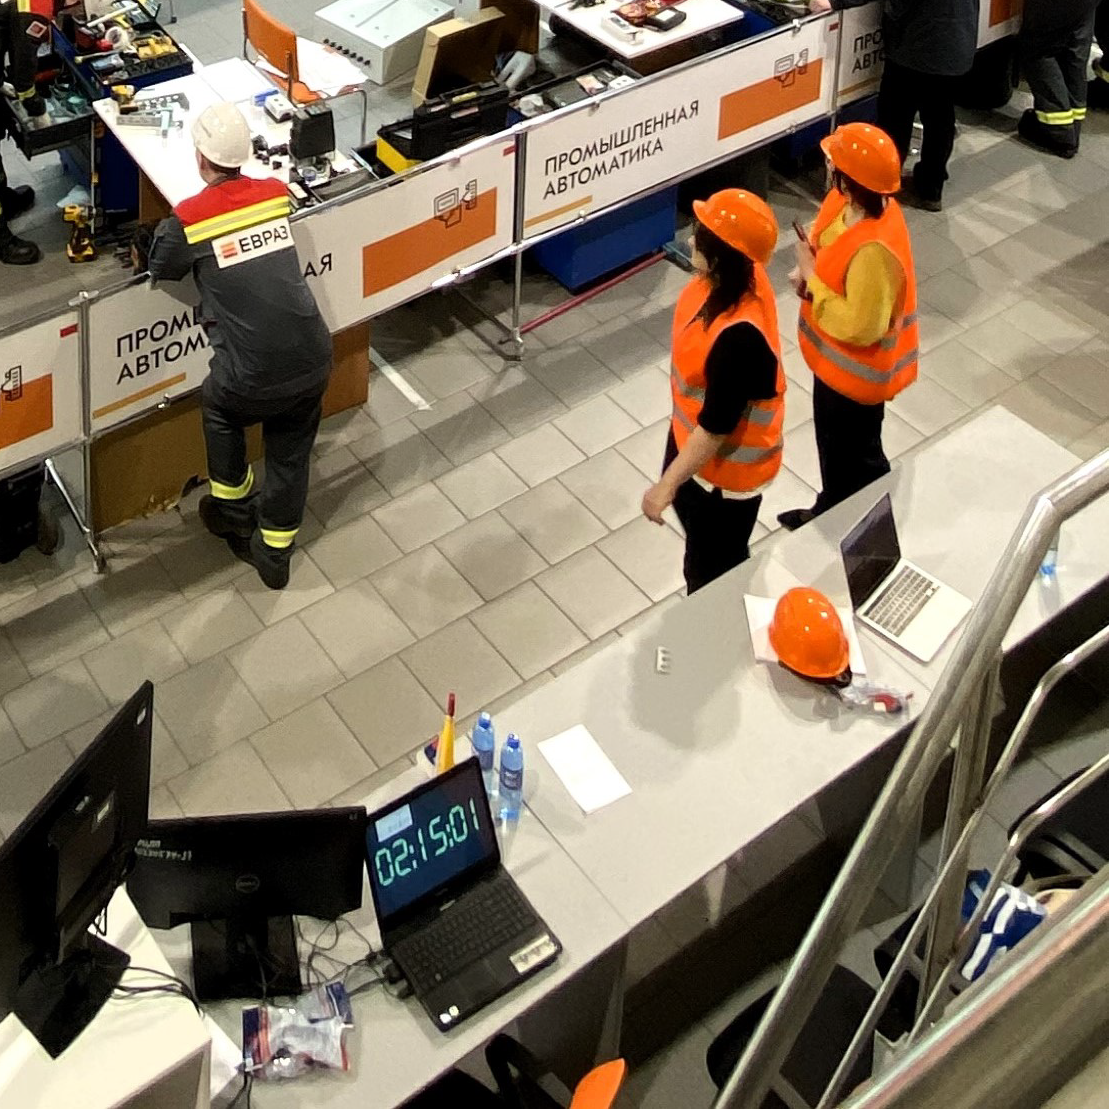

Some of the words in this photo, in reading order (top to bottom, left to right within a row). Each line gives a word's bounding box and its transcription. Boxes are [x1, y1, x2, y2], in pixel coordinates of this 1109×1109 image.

[543, 138, 663, 200] АВТОМАТИКА
[545, 100, 699, 176] ПРОМЫШЛЕННАЯ
[239, 225, 289, 253] ЕВРАЗ
[375, 797, 479, 886] 02:15:01
